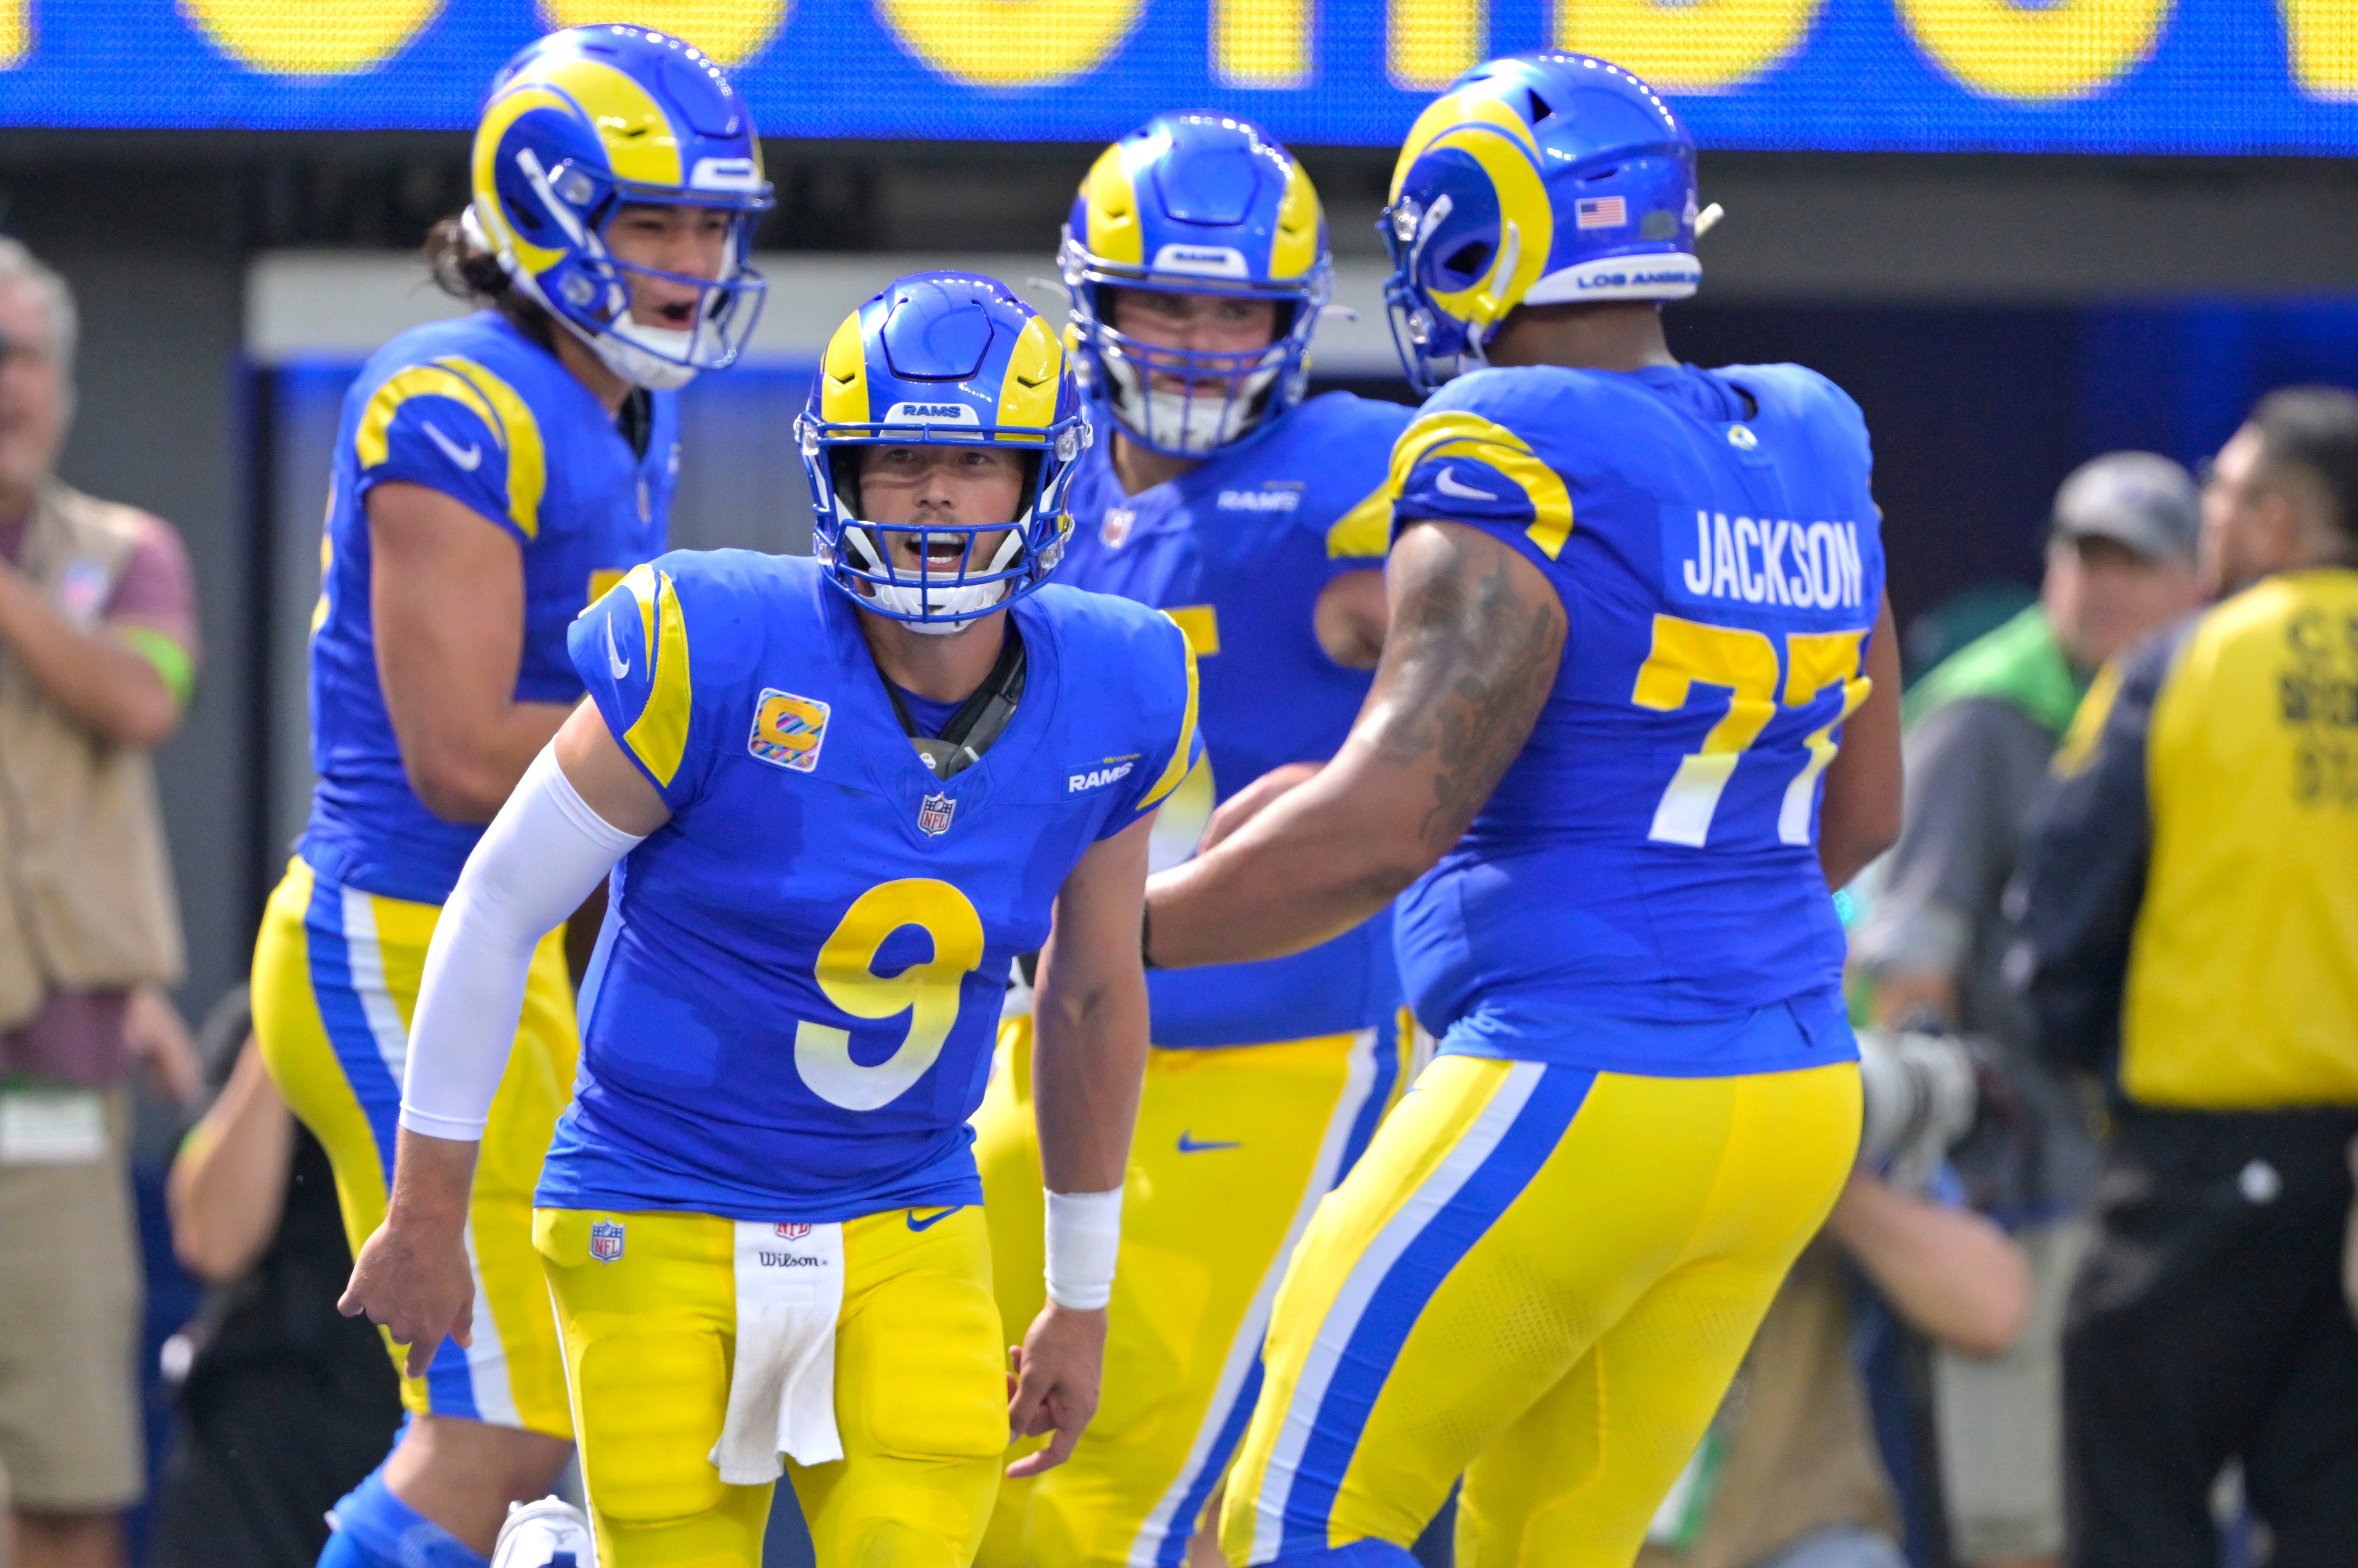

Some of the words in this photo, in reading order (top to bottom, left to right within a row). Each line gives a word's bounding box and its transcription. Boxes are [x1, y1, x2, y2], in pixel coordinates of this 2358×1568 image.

[1577, 273, 1627, 288] LOS
[903, 405, 961, 417] RAMS
[1217, 489, 1301, 512] RAMS
[1683, 510, 1863, 610] JACKSON
[759, 697, 825, 751] C
[1631, 613, 1872, 847] 77
[1069, 762, 1133, 793] RAMS
[923, 812, 945, 830] NFL
[794, 878, 985, 1125] 9
[595, 1238, 618, 1256] NFL
[759, 1251, 819, 1267] Wilson
